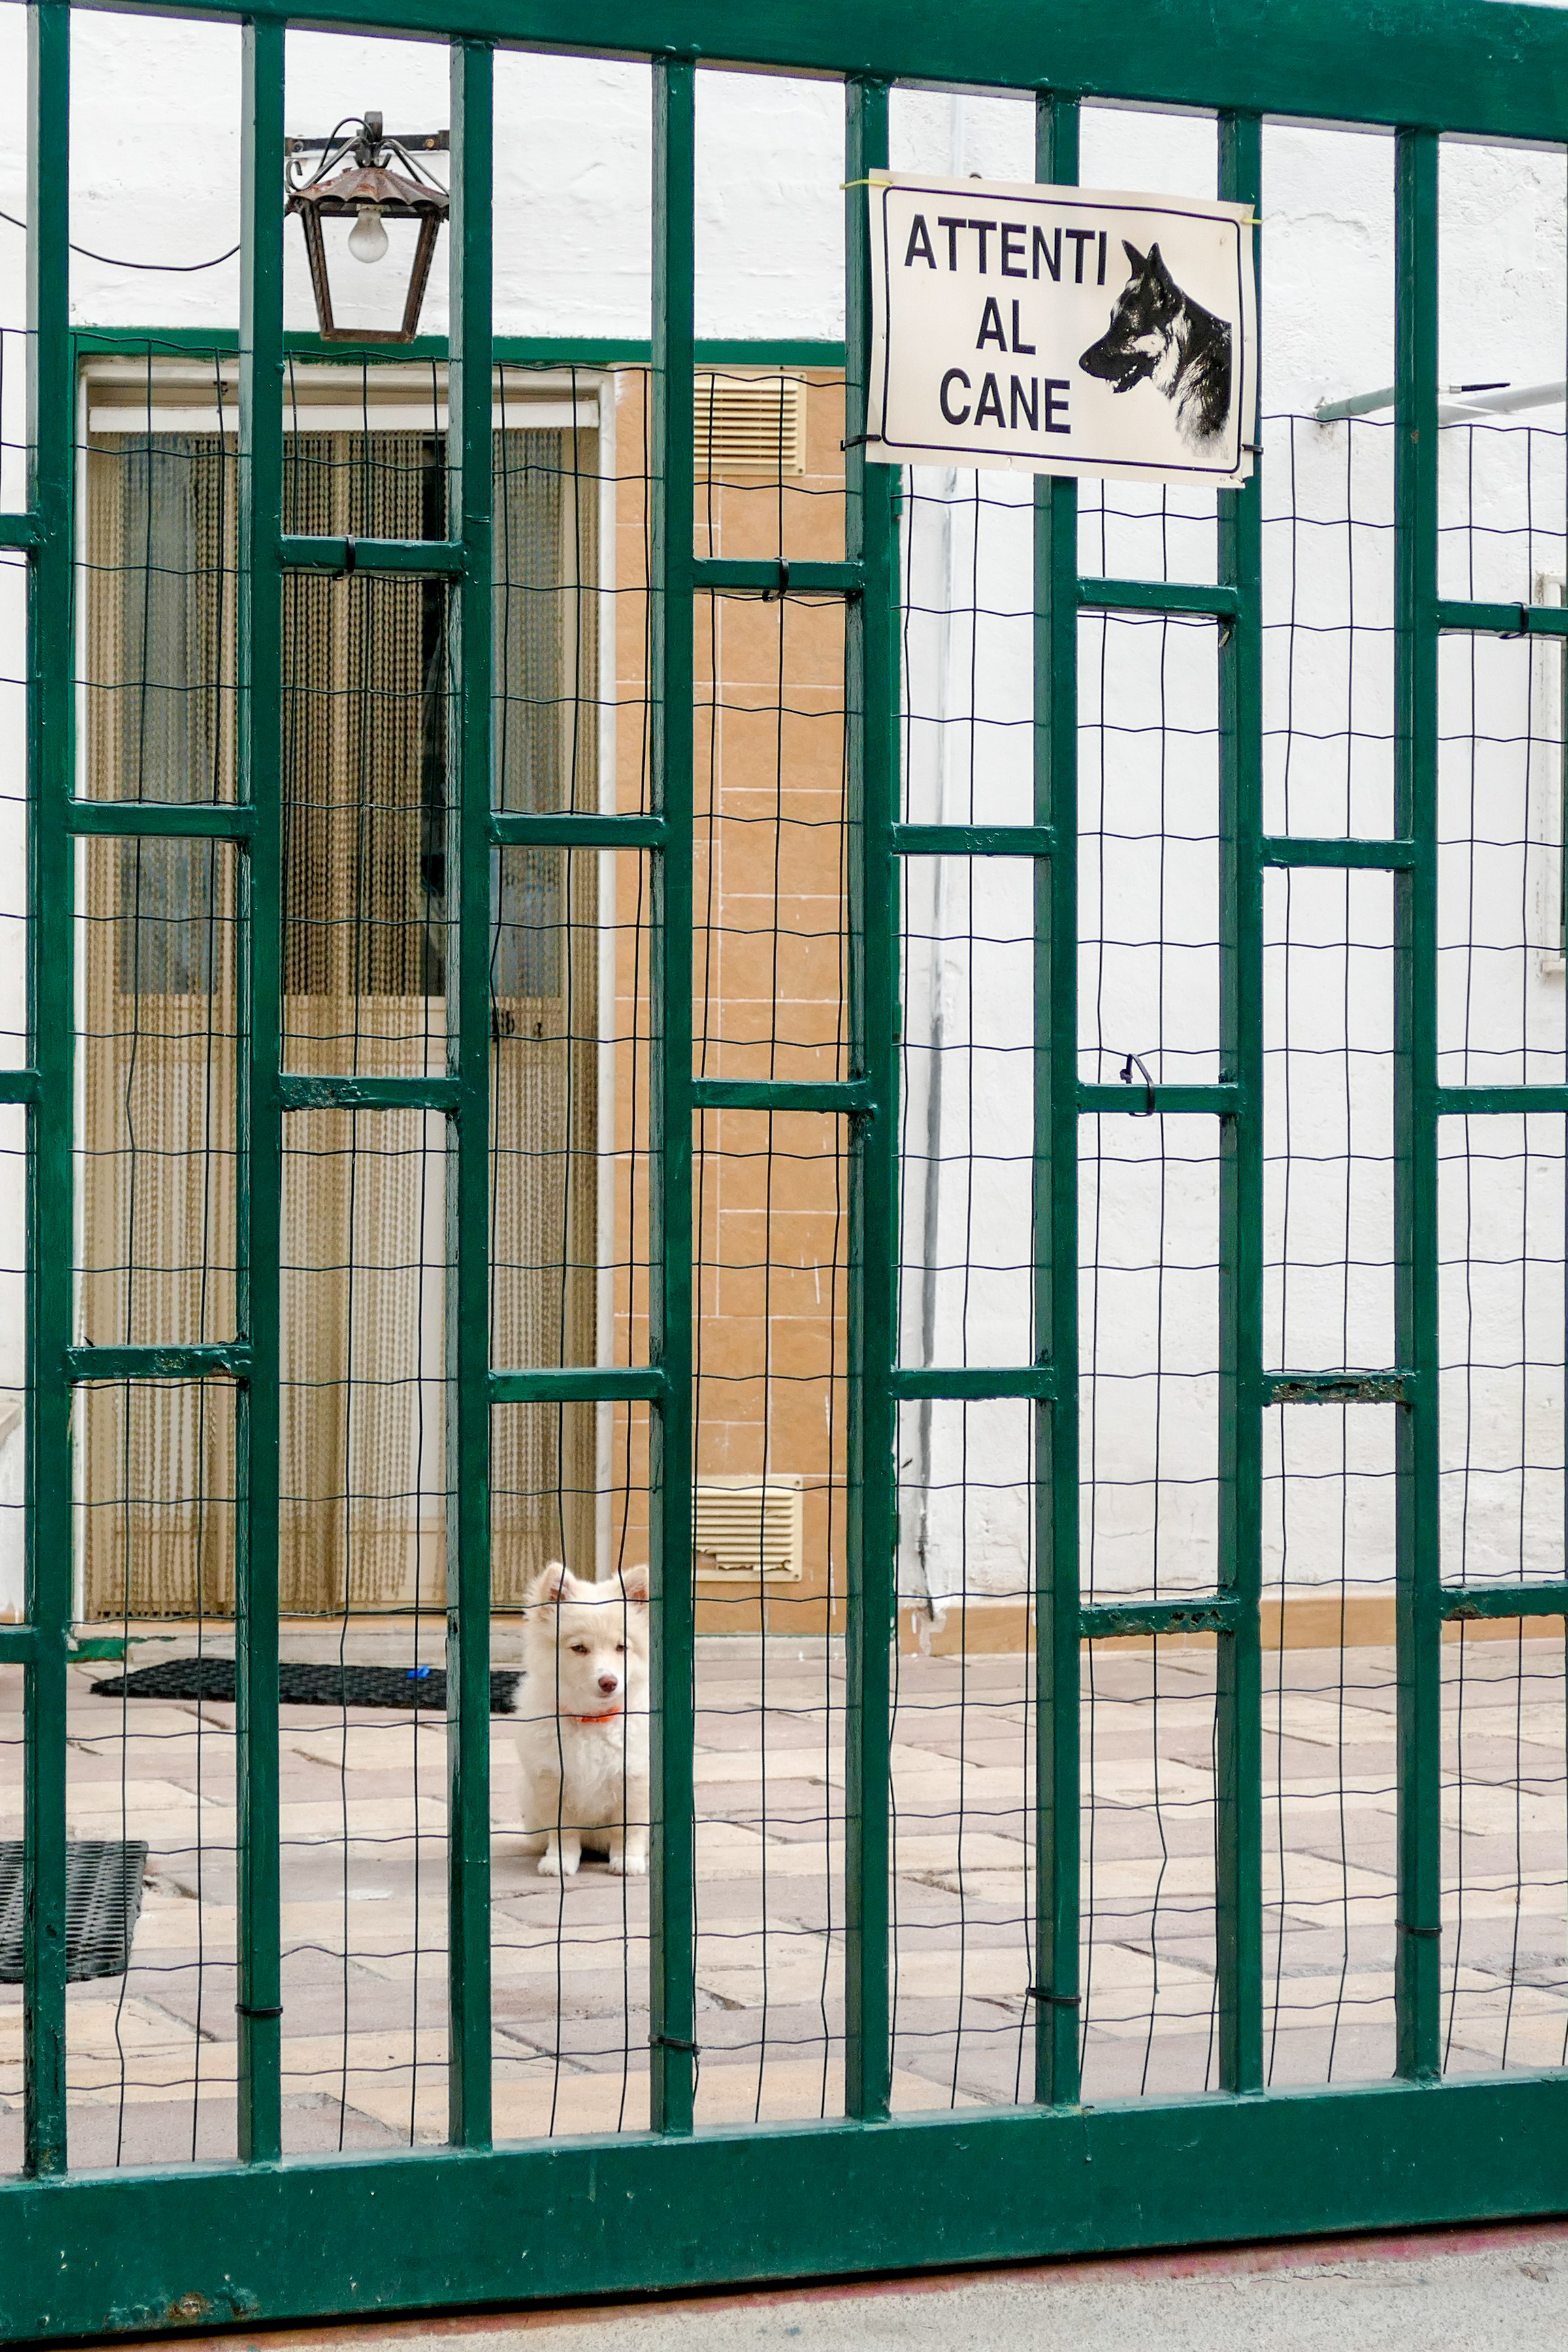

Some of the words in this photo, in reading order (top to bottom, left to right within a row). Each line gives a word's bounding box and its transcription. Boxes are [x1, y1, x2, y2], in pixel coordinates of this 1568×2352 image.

[904, 214, 1107, 286] ATTENTI
[975, 297, 1036, 355] AL
[939, 368, 1071, 434] CANE
